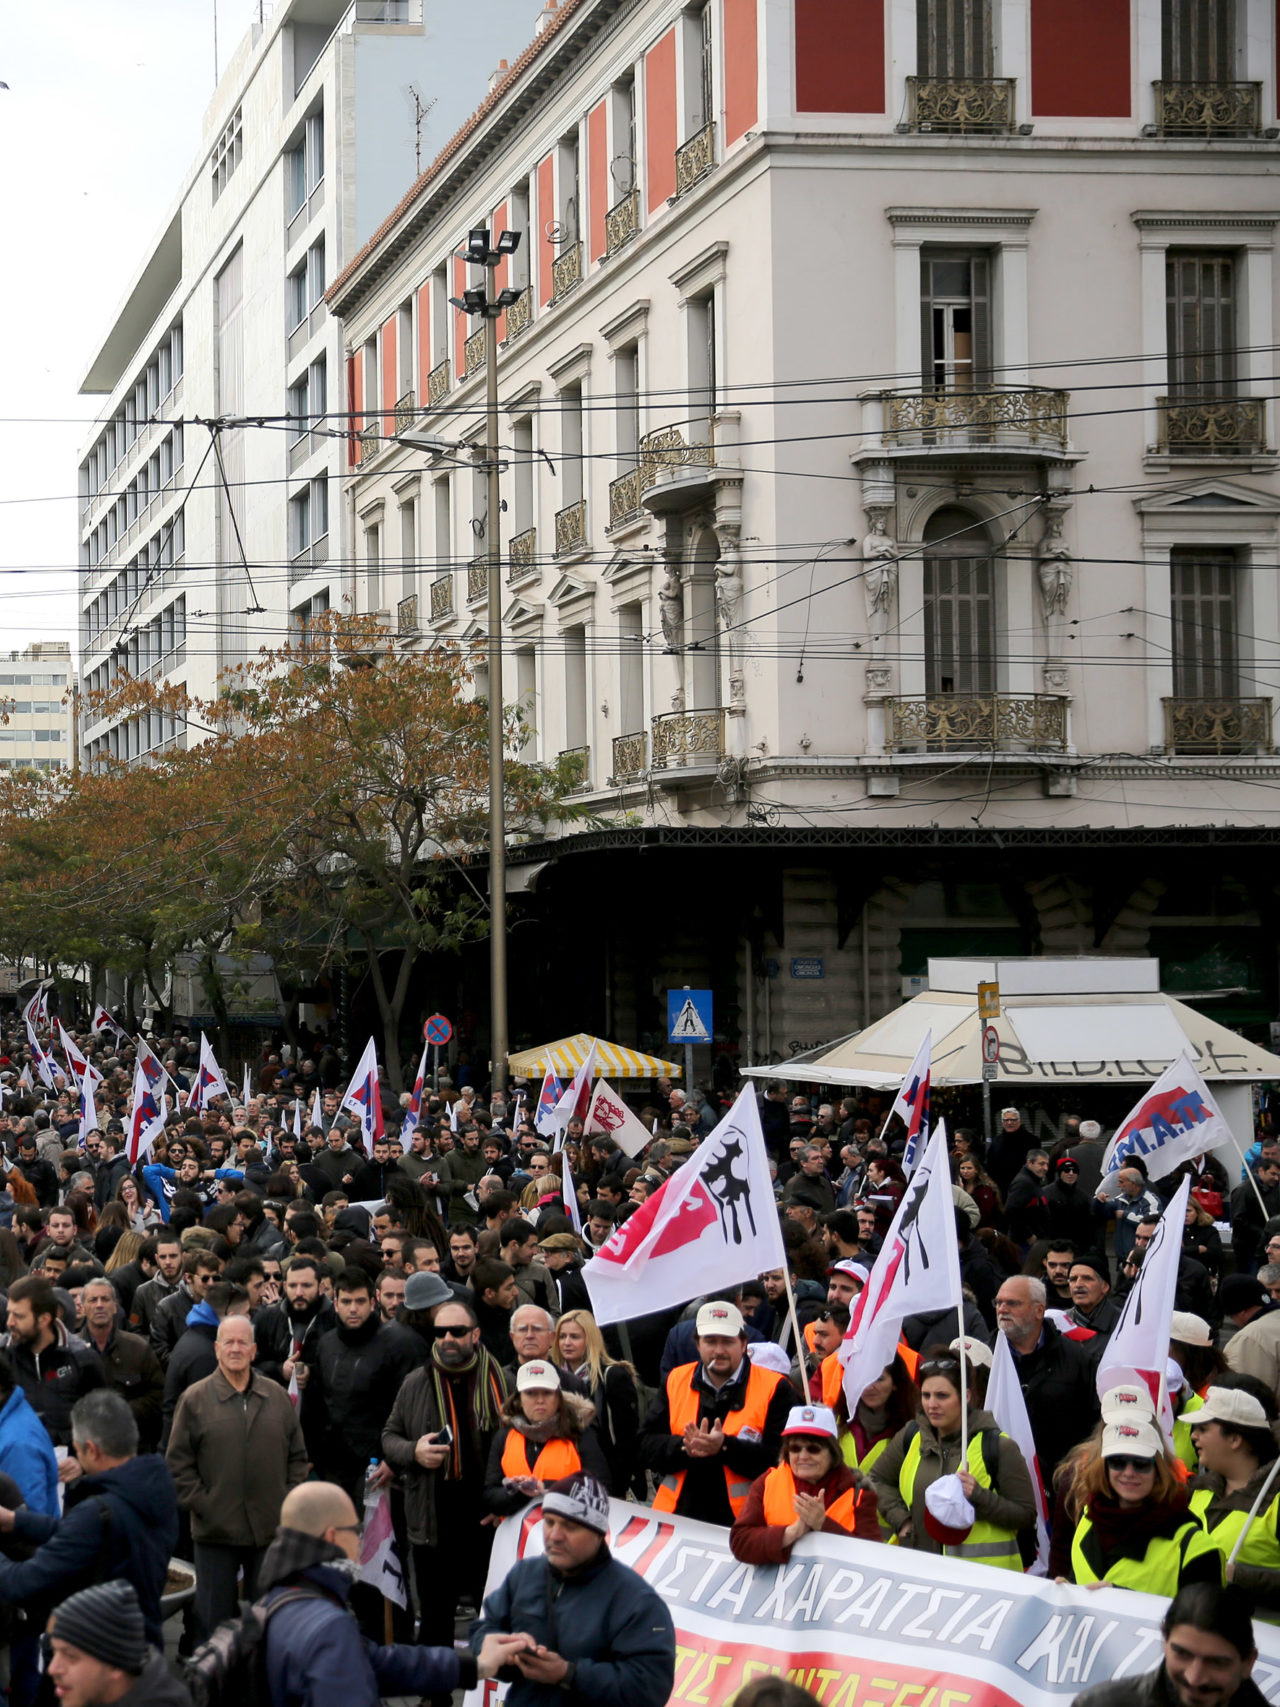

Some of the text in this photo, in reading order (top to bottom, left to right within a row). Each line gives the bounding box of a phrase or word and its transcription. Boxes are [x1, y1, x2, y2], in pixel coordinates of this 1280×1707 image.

[655, 1546, 758, 1616] ΣΤΑ
[754, 1560, 1015, 1652] ΧΑΡΑΤΣΙΑ
[1015, 1614, 1120, 1684] ΚΑΙ
